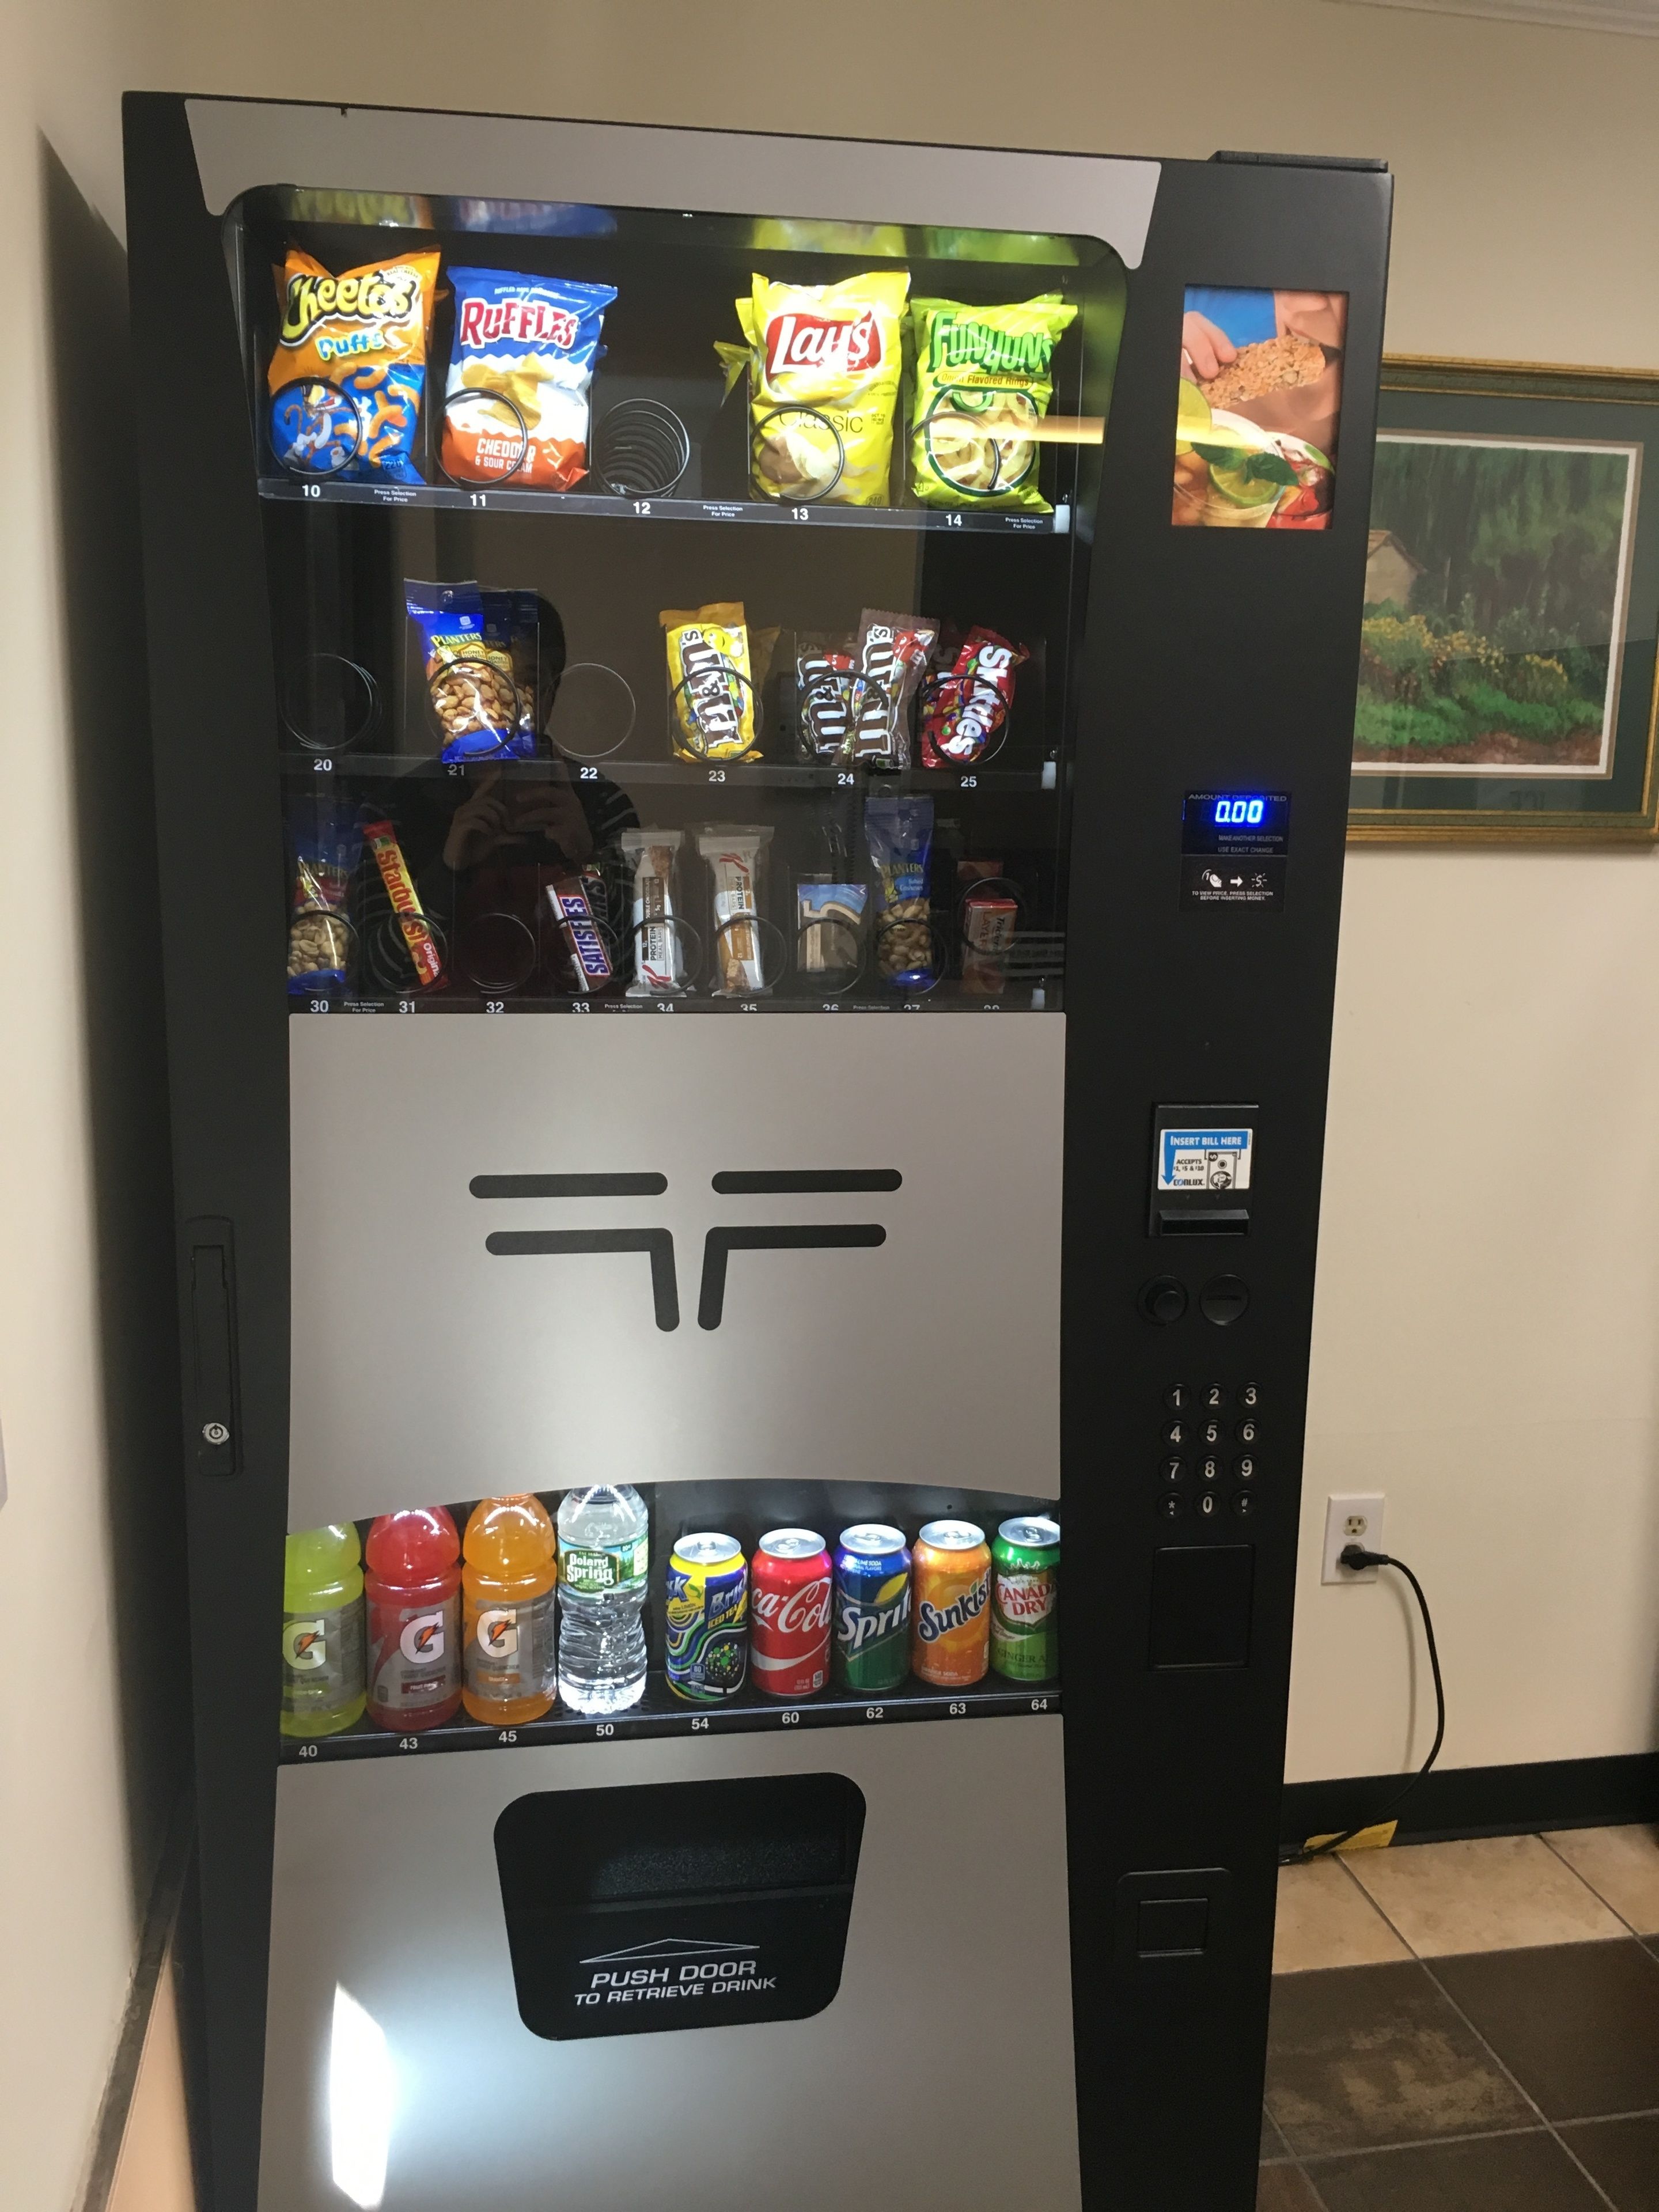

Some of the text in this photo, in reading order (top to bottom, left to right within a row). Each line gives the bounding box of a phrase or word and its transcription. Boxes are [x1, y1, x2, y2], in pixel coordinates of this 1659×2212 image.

[282, 272, 416, 340] Cheetos
[461, 301, 576, 347] RUFFLES
[318, 332, 382, 359] Puffs
[929, 312, 1054, 378] FUNYUNS
[967, 374, 1002, 385] Flavored
[1005, 376, 1029, 388] Rings
[476, 438, 536, 463] CHEDDR
[475, 456, 481, 465] &
[483, 456, 504, 469] SOUR
[302, 484, 321, 497] 10
[470, 494, 486, 507] 11
[633, 502, 651, 514] 12
[791, 507, 809, 521] 13
[945, 514, 963, 527] 14
[431, 632, 482, 647] PLANTERS
[940, 645, 1013, 756] Skittles
[313, 759, 332, 771] 20
[448, 764, 465, 777] 21
[580, 767, 598, 779] 22
[709, 770, 726, 782] 23
[838, 773, 855, 786] 24
[961, 776, 978, 789] 25
[1215, 800, 1264, 823] 0.00
[735, 876, 744, 910] PROTEIN
[310, 999, 329, 1013] 30
[399, 1001, 415, 1013] 31
[486, 1001, 504, 1013] 32
[572, 1002, 590, 1013] 33
[657, 1003, 675, 1012] 34
[1170, 1135, 1199, 1146] INSERT
[1202, 1137, 1218, 1145] BILL
[1221, 1137, 1242, 1145] HERE
[1173, 1387, 1257, 1406] 1 2 3
[1170, 1423, 1255, 1442] 4 5 6
[1169, 1459, 1253, 1479] 7 8 9
[1203, 1497, 1213, 1513] 0
[569, 1553, 608, 1569] Poland
[567, 1565, 614, 1586] Spring
[995, 1582, 1051, 1605] CANAD
[919, 1566, 991, 1642] Sunkist
[1012, 1600, 1047, 1616] DRY
[708, 1604, 738, 1629] ICED TEA
[400, 1611, 444, 1664] G
[477, 1609, 518, 1658] G
[282, 1619, 326, 1670] G
[996, 1647, 1036, 1663] GINGER
[950, 1703, 967, 1715] 63
[1031, 1698, 1048, 1711] 64
[782, 1712, 800, 1725] 60
[866, 1707, 884, 1719] 62
[596, 1724, 614, 1736] 50
[691, 1717, 709, 1730] 54
[399, 1737, 418, 1750] 43
[498, 1730, 517, 1743] 45
[299, 1745, 318, 1758] 40
[591, 1961, 757, 1988] PUSH DOOR
[575, 1976, 778, 2005] TO RETRIEVE DRINK
